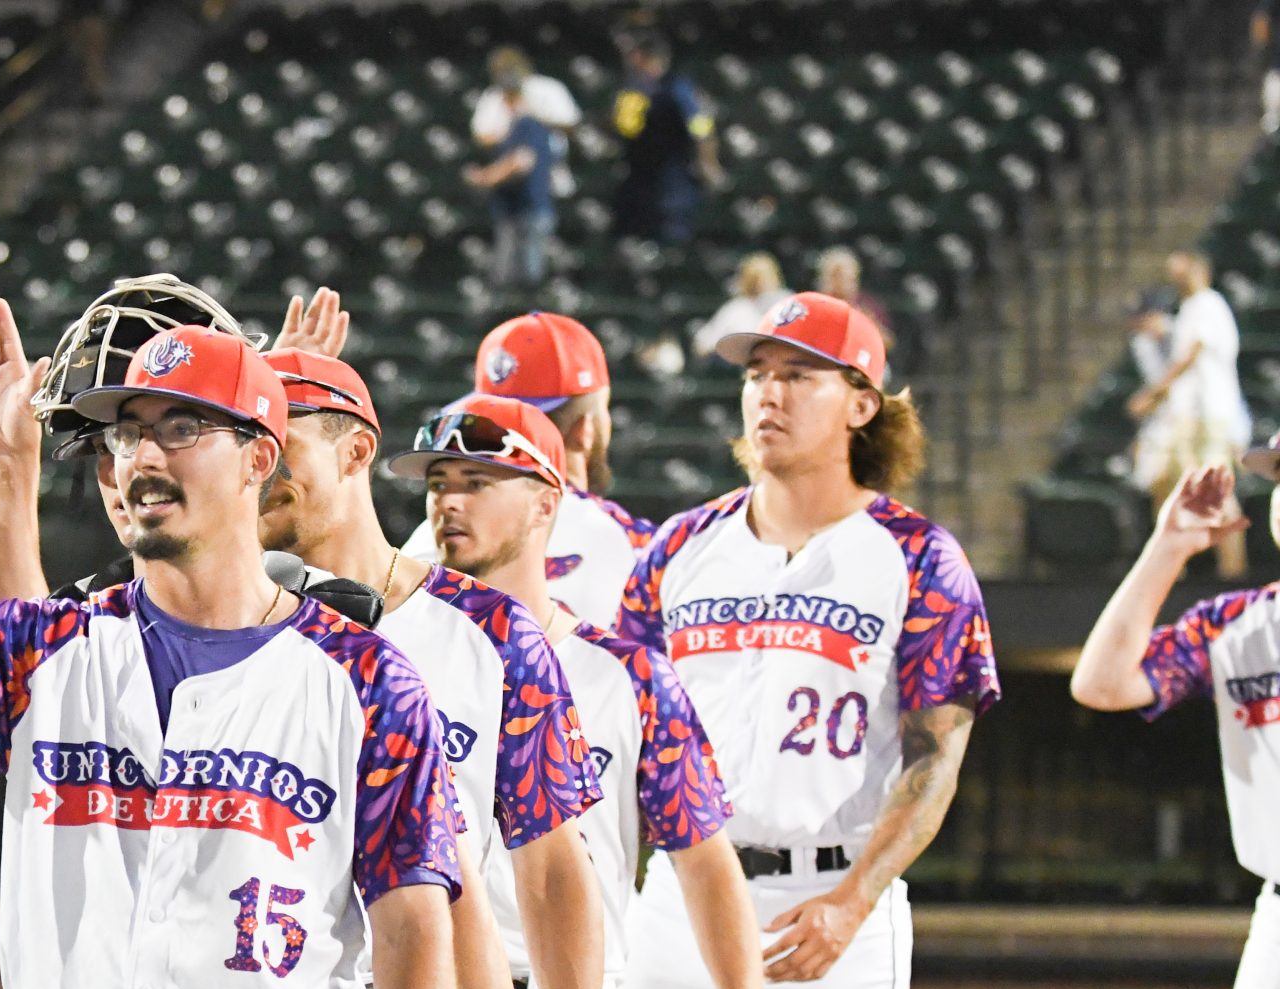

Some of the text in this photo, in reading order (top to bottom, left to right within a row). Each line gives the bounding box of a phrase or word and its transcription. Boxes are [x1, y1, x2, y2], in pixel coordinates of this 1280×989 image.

[687, 624, 824, 652] DE UTICA
[779, 686, 868, 760] 20
[38, 747, 329, 820] UNICORNIOS
[87, 789, 263, 830] DE UTICA
[224, 877, 307, 978] 15
